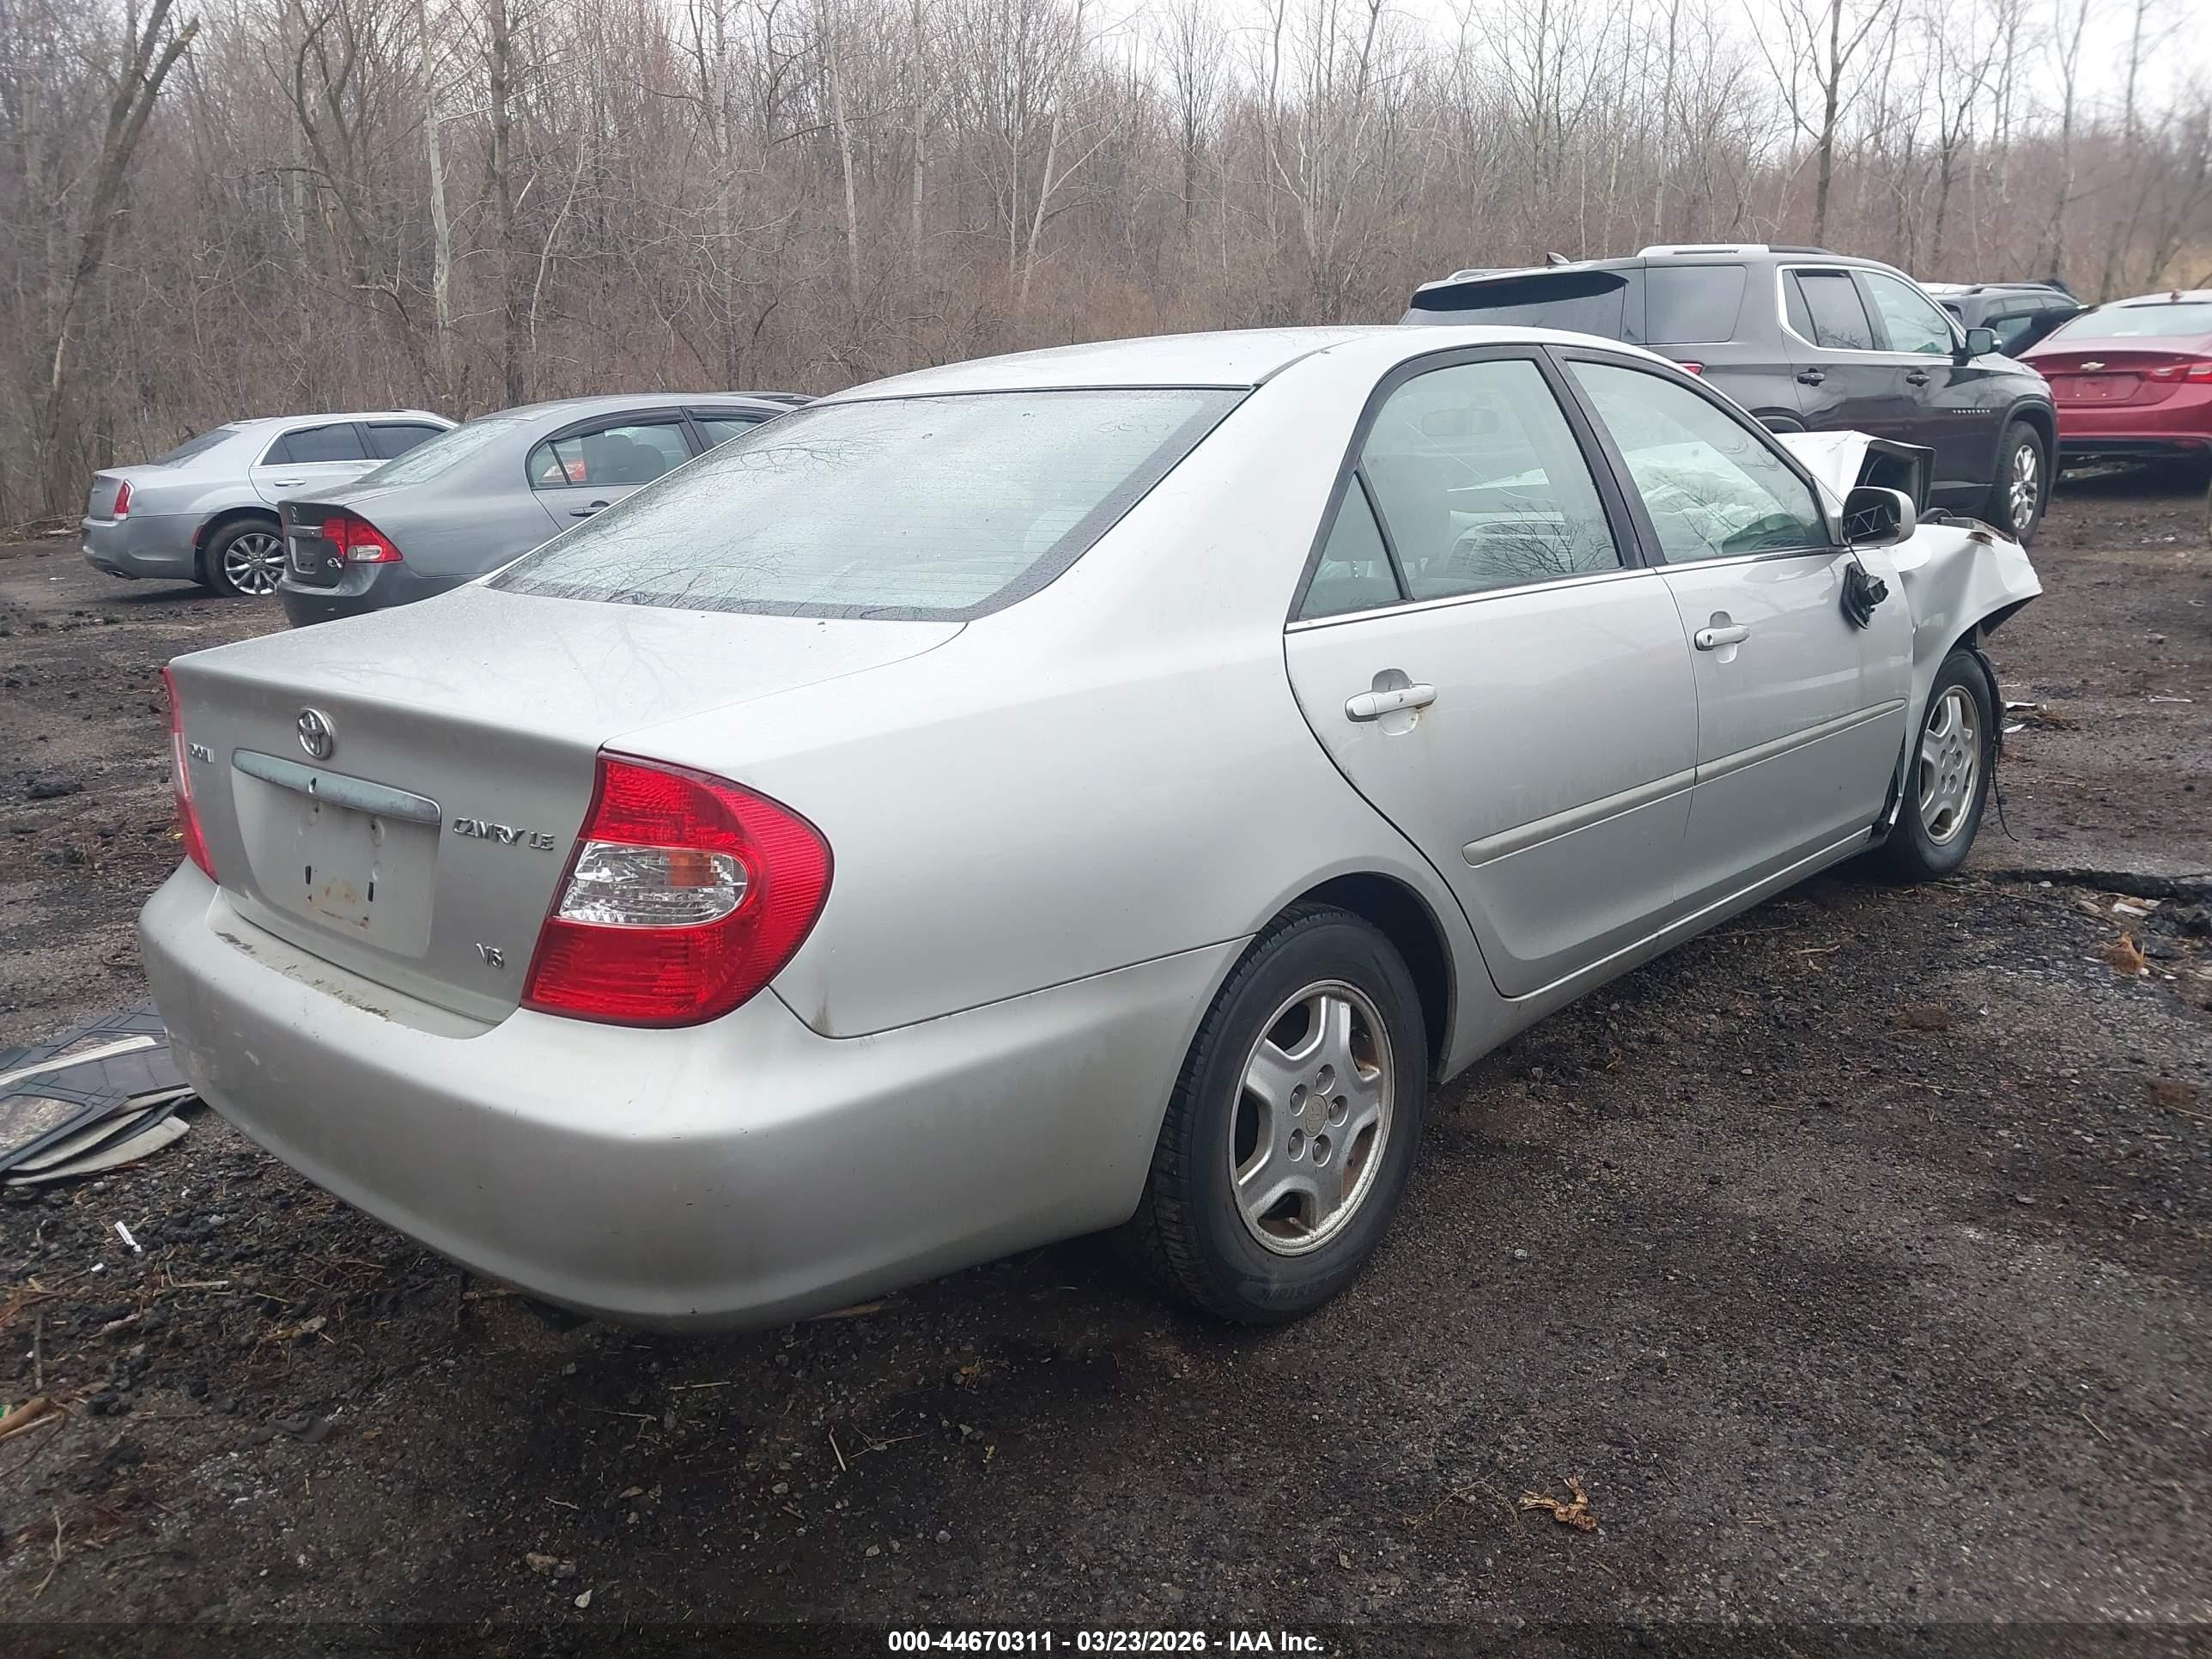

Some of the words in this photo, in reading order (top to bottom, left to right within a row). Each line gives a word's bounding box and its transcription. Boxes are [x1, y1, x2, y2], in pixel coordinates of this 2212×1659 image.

[453, 817, 526, 845] CAMRY
[528, 830, 555, 851] LE
[475, 943, 504, 968] V6
